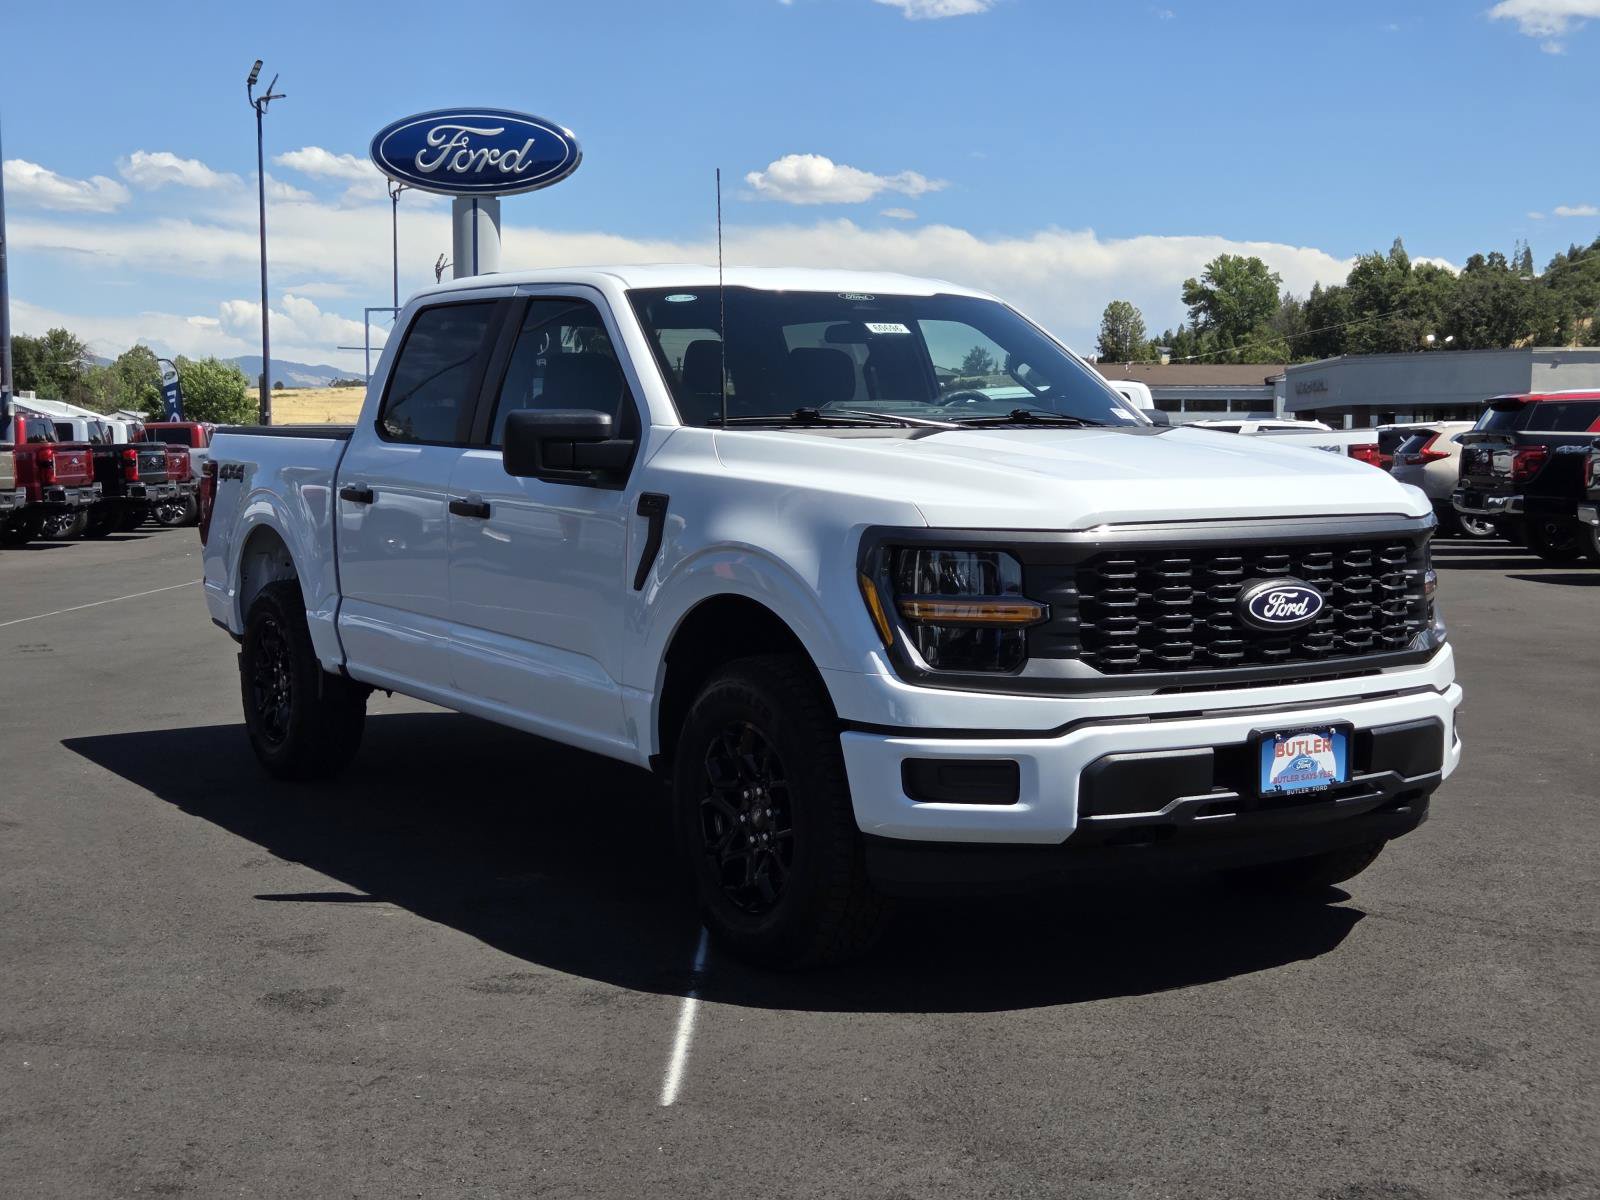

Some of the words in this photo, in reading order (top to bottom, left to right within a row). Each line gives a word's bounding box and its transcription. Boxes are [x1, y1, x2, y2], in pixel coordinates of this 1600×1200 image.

[414, 124, 535, 174] Ford
[1263, 591, 1309, 618] Ford
[1274, 738, 1332, 758] BUTLER
[1272, 774, 1299, 785] BUTLER
[1301, 771, 1318, 780] SAYS
[1286, 787, 1309, 796] BUTLER
[1312, 784, 1328, 792] FORD
